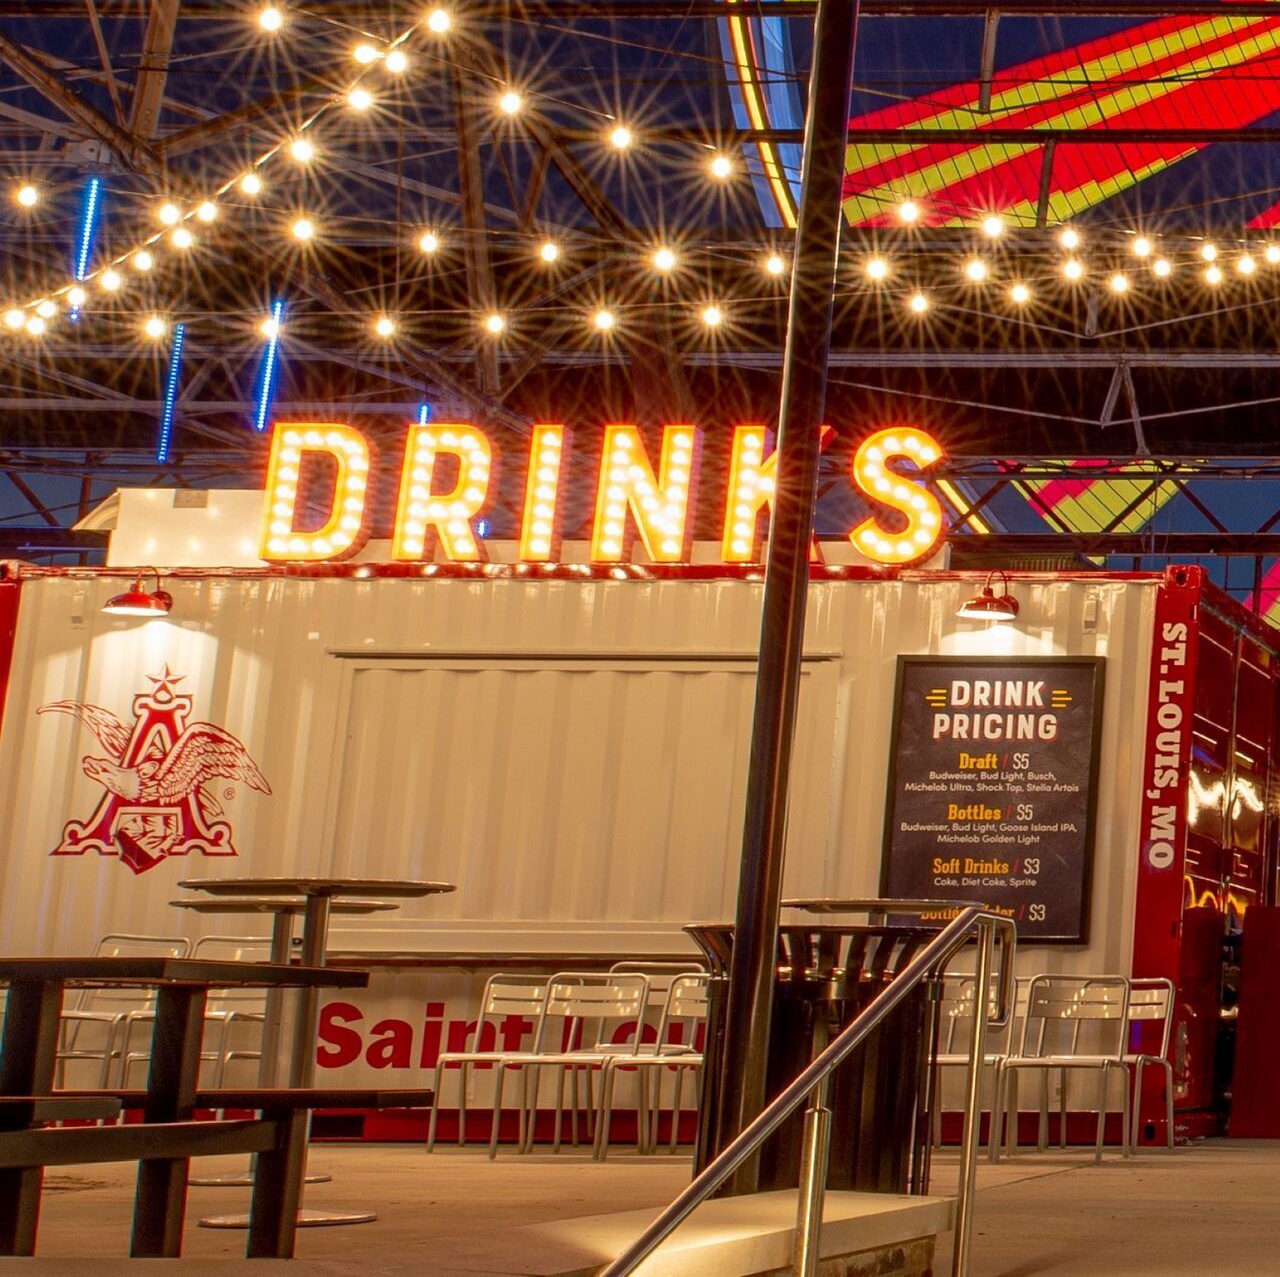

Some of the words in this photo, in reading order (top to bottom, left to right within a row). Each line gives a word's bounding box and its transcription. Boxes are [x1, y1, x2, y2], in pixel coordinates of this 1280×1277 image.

[258, 423, 947, 566] DRINKS
[1160, 622, 1187, 674] ST.
[950, 680, 1045, 707] DRINK
[932, 713, 1058, 740] PRICING
[1146, 679, 1185, 799] LOUIS,
[959, 752, 998, 770] Draft
[929, 771, 977, 781] Budweiser,
[980, 771, 999, 780] Bud
[1001, 771, 1025, 782] Light,
[1027, 772, 1056, 781] Busch,
[904, 782, 947, 792] Michelob
[950, 782, 974, 792] Ultra,
[976, 782, 1003, 792] Shock
[1006, 783, 1024, 793] Top,
[1026, 783, 1051, 792] Stella
[1053, 783, 1079, 792] Artois
[947, 803, 1002, 821] Bottles
[900, 822, 950, 832] Budweiser,
[952, 822, 970, 832] Bud
[972, 822, 997, 833] Light,
[999, 822, 1028, 832] Goose
[1031, 823, 1058, 832] Island
[1060, 823, 1077, 832] IPA,
[937, 834, 980, 843] Michelob
[982, 834, 1015, 844] Golden
[1017, 835, 1040, 845] Light
[1148, 805, 1177, 869] MO
[933, 858, 960, 874] Soft
[965, 858, 1009, 874] Drinks
[933, 877, 959, 887] Coke,
[961, 877, 980, 886] Diet
[982, 877, 1008, 887] Coke,
[1009, 877, 1037, 888] Sprite
[316, 1001, 534, 1070] Saint
